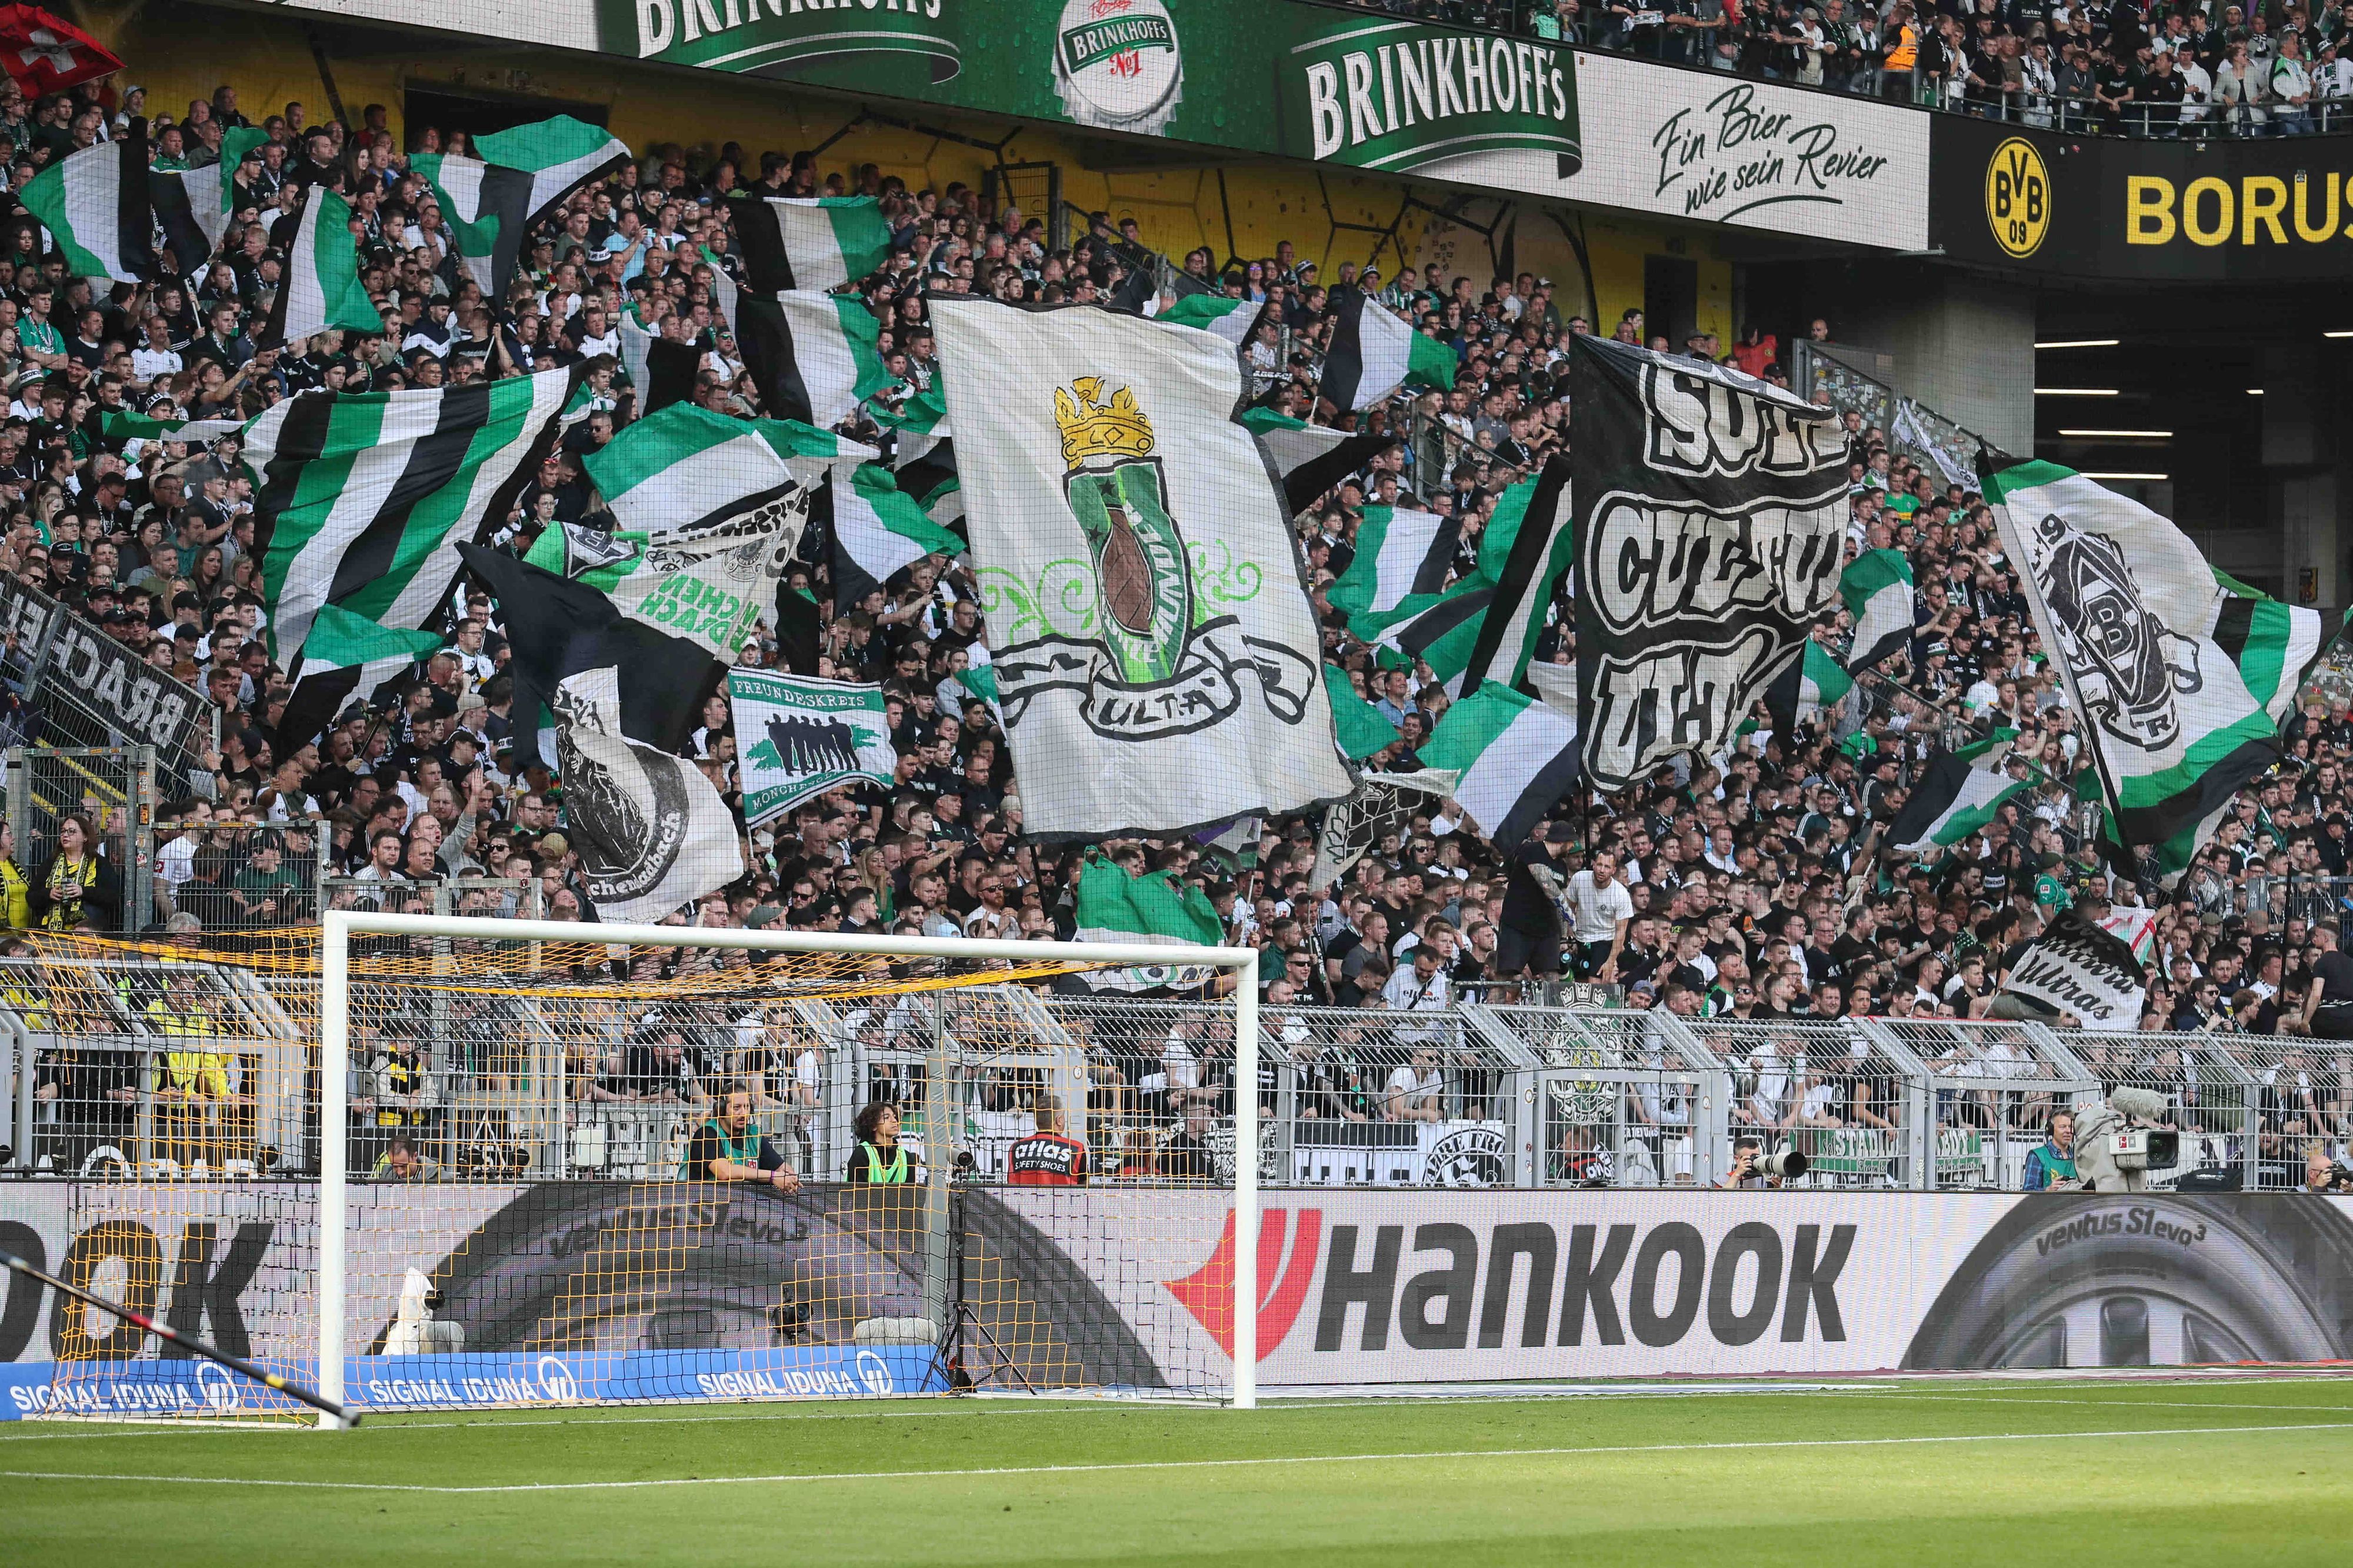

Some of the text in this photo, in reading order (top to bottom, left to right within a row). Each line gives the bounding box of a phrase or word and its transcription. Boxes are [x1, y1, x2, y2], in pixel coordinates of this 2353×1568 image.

[1306, 37, 1567, 161] BRINKHOFF's
[1652, 84, 1791, 197] Ein Bier
[1685, 124, 1887, 214] wie sein Revier
[1995, 150, 2043, 228] BVB
[2008, 219, 2027, 245] 09
[734, 680, 865, 707] FREUNDESKREIS
[1402, 989, 1439, 1003] ellsse
[2015, 954, 2114, 1020] Ultras
[1015, 1140, 1072, 1162] atlas
[1014, 1160, 1066, 1172] SAFETY SHOES
[368, 1377, 541, 1403] SIGNAL IDUNA
[696, 1370, 859, 1396] SIGNAL IDUNA
[9, 1383, 196, 1411] SIGNAL IDUNA
